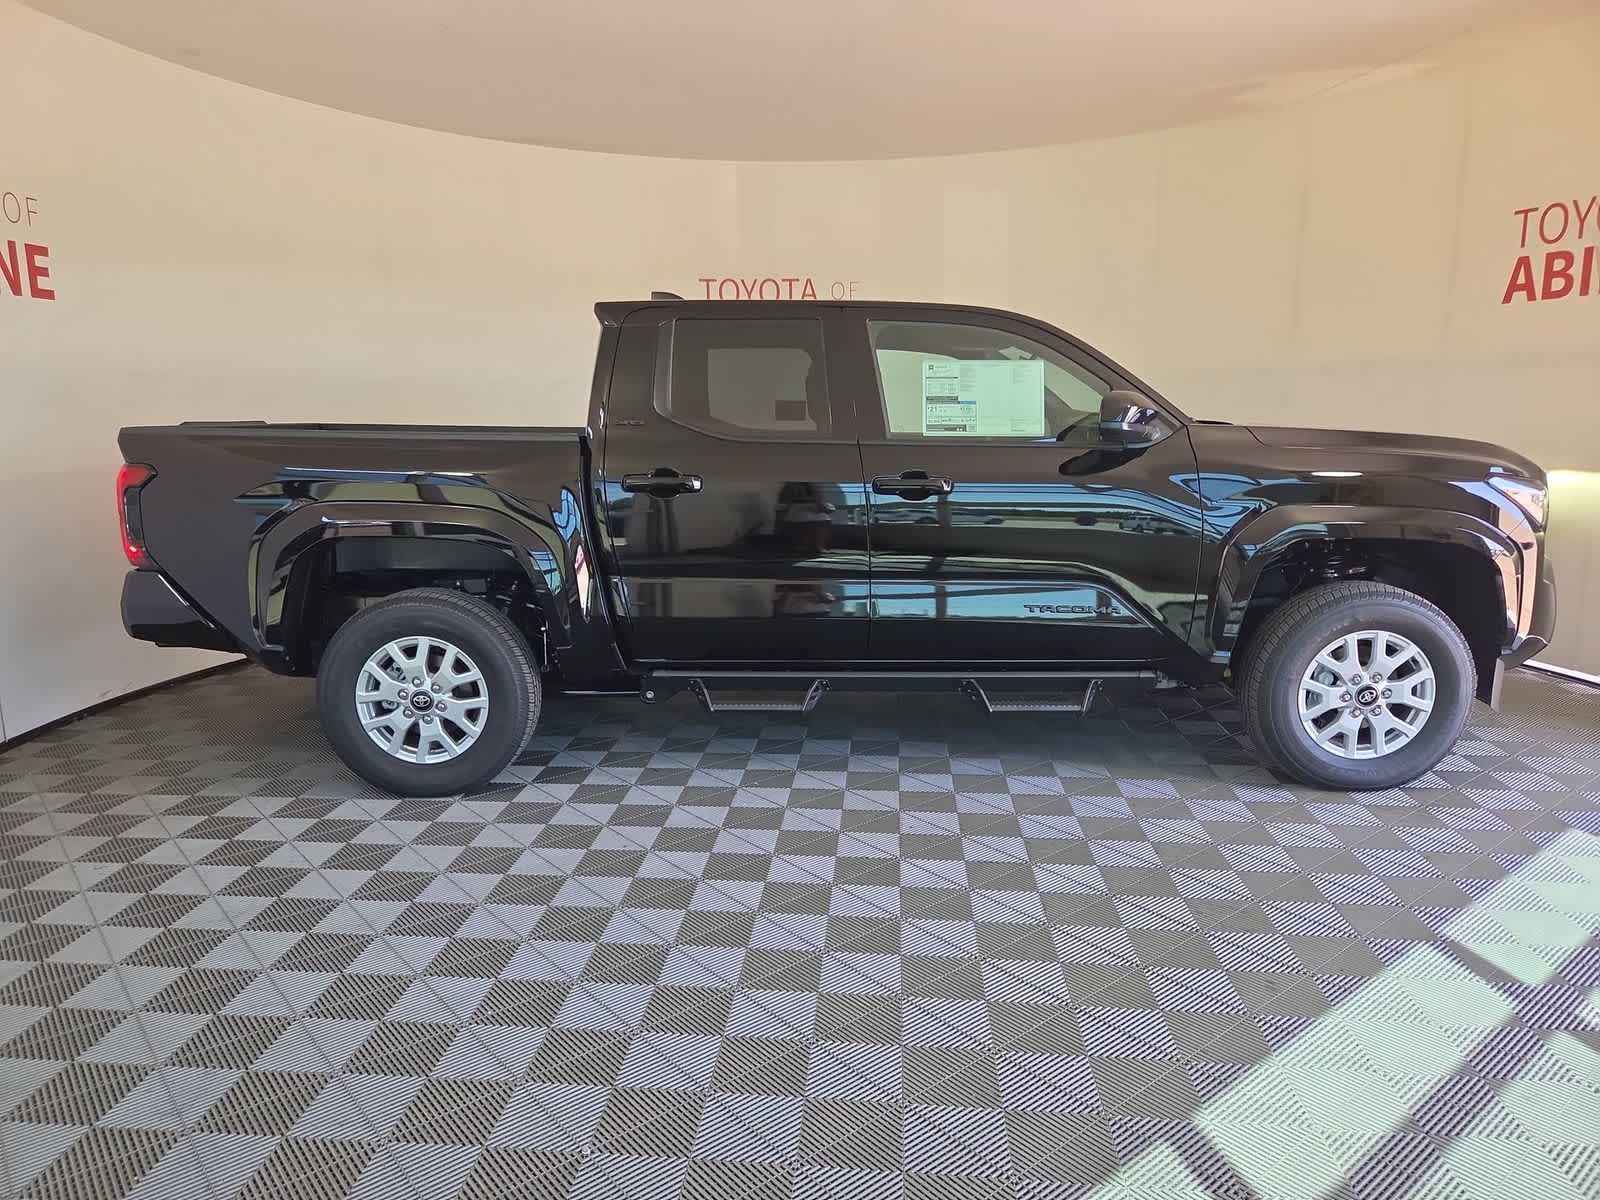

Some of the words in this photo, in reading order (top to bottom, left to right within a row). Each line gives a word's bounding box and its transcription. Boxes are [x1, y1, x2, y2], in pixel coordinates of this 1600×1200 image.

[3, 191, 38, 227] OF
[1514, 195, 1600, 248] TOY
[698, 278, 817, 300] TOYOTA
[831, 280, 860, 300] OF
[1501, 246, 1600, 304] ABI
[1024, 604, 1121, 614] TACOMA
